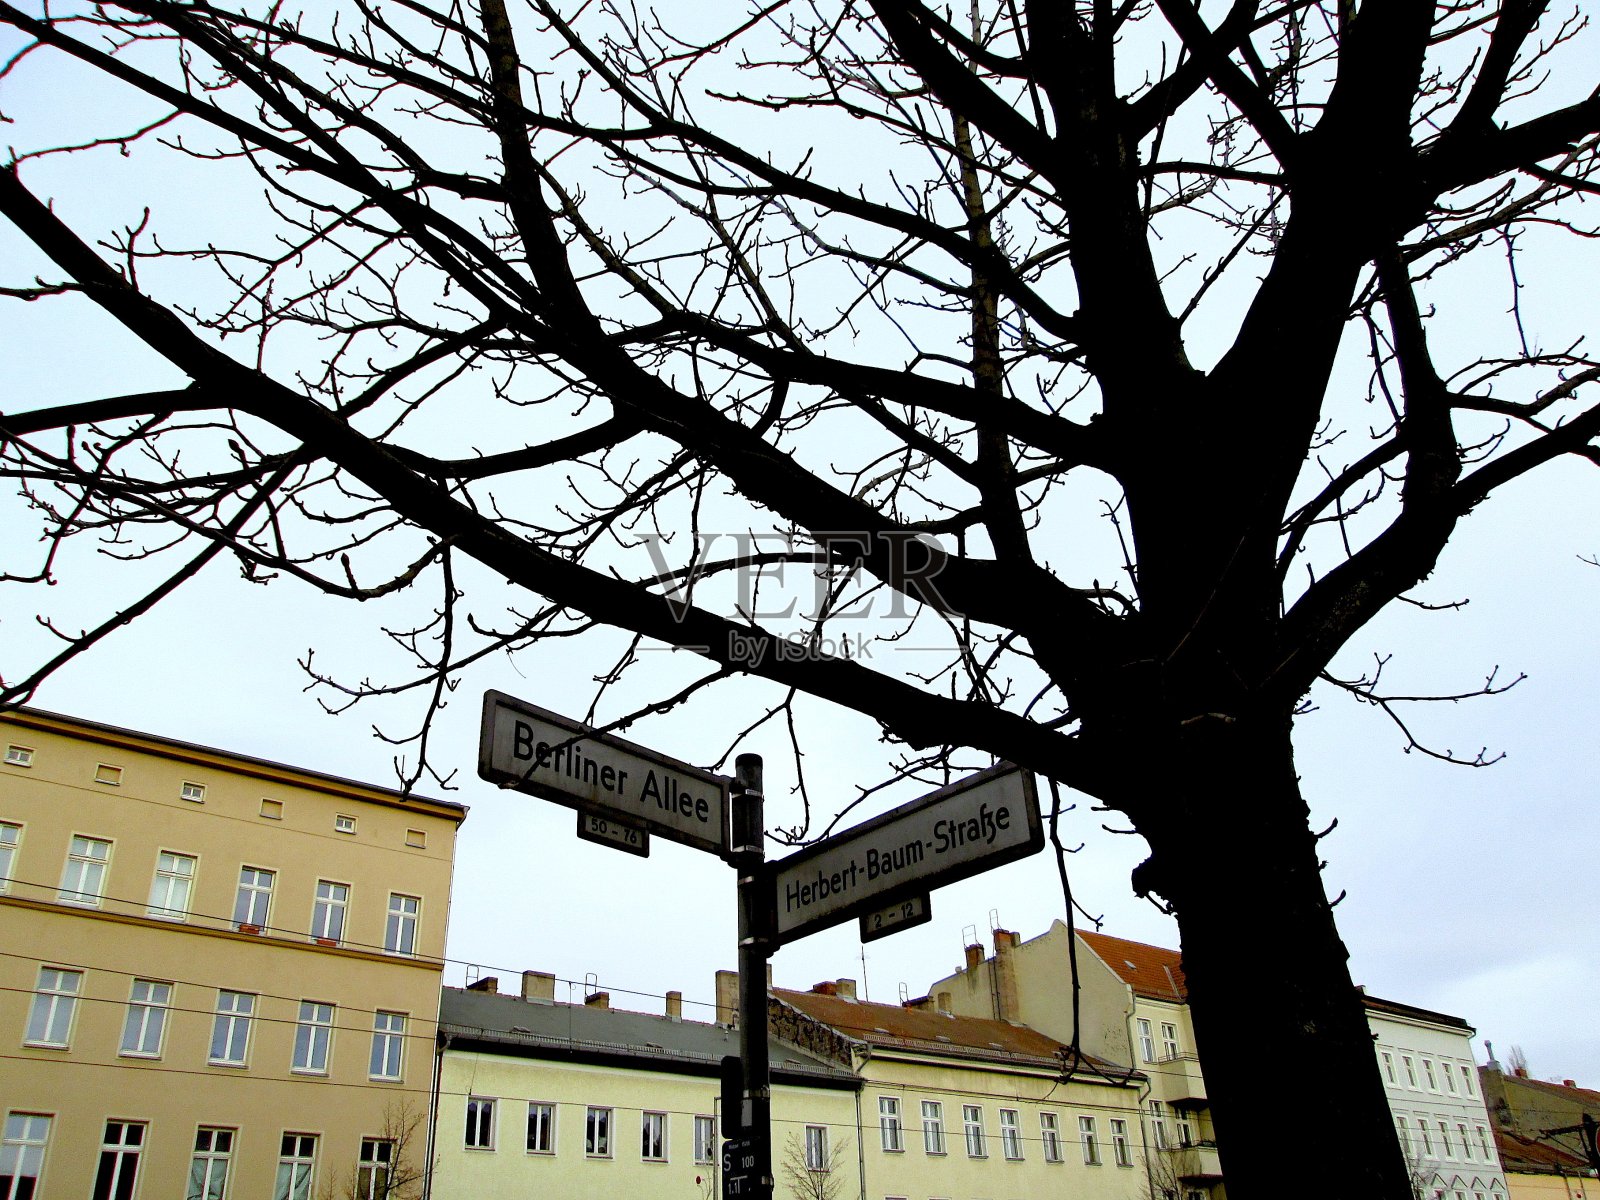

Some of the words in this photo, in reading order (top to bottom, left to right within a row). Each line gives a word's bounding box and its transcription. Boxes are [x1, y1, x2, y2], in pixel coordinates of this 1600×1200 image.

[514, 719, 628, 795] Berliner
[640, 769, 709, 823] Allee
[591, 817, 608, 834] 50
[624, 828, 638, 844] 76
[786, 803, 1010, 913] Herbert-Baum-Straße
[874, 914, 882, 929] 2
[901, 902, 914, 919] 12
[723, 1153, 732, 1172] S
[741, 1155, 755, 1169] 100
